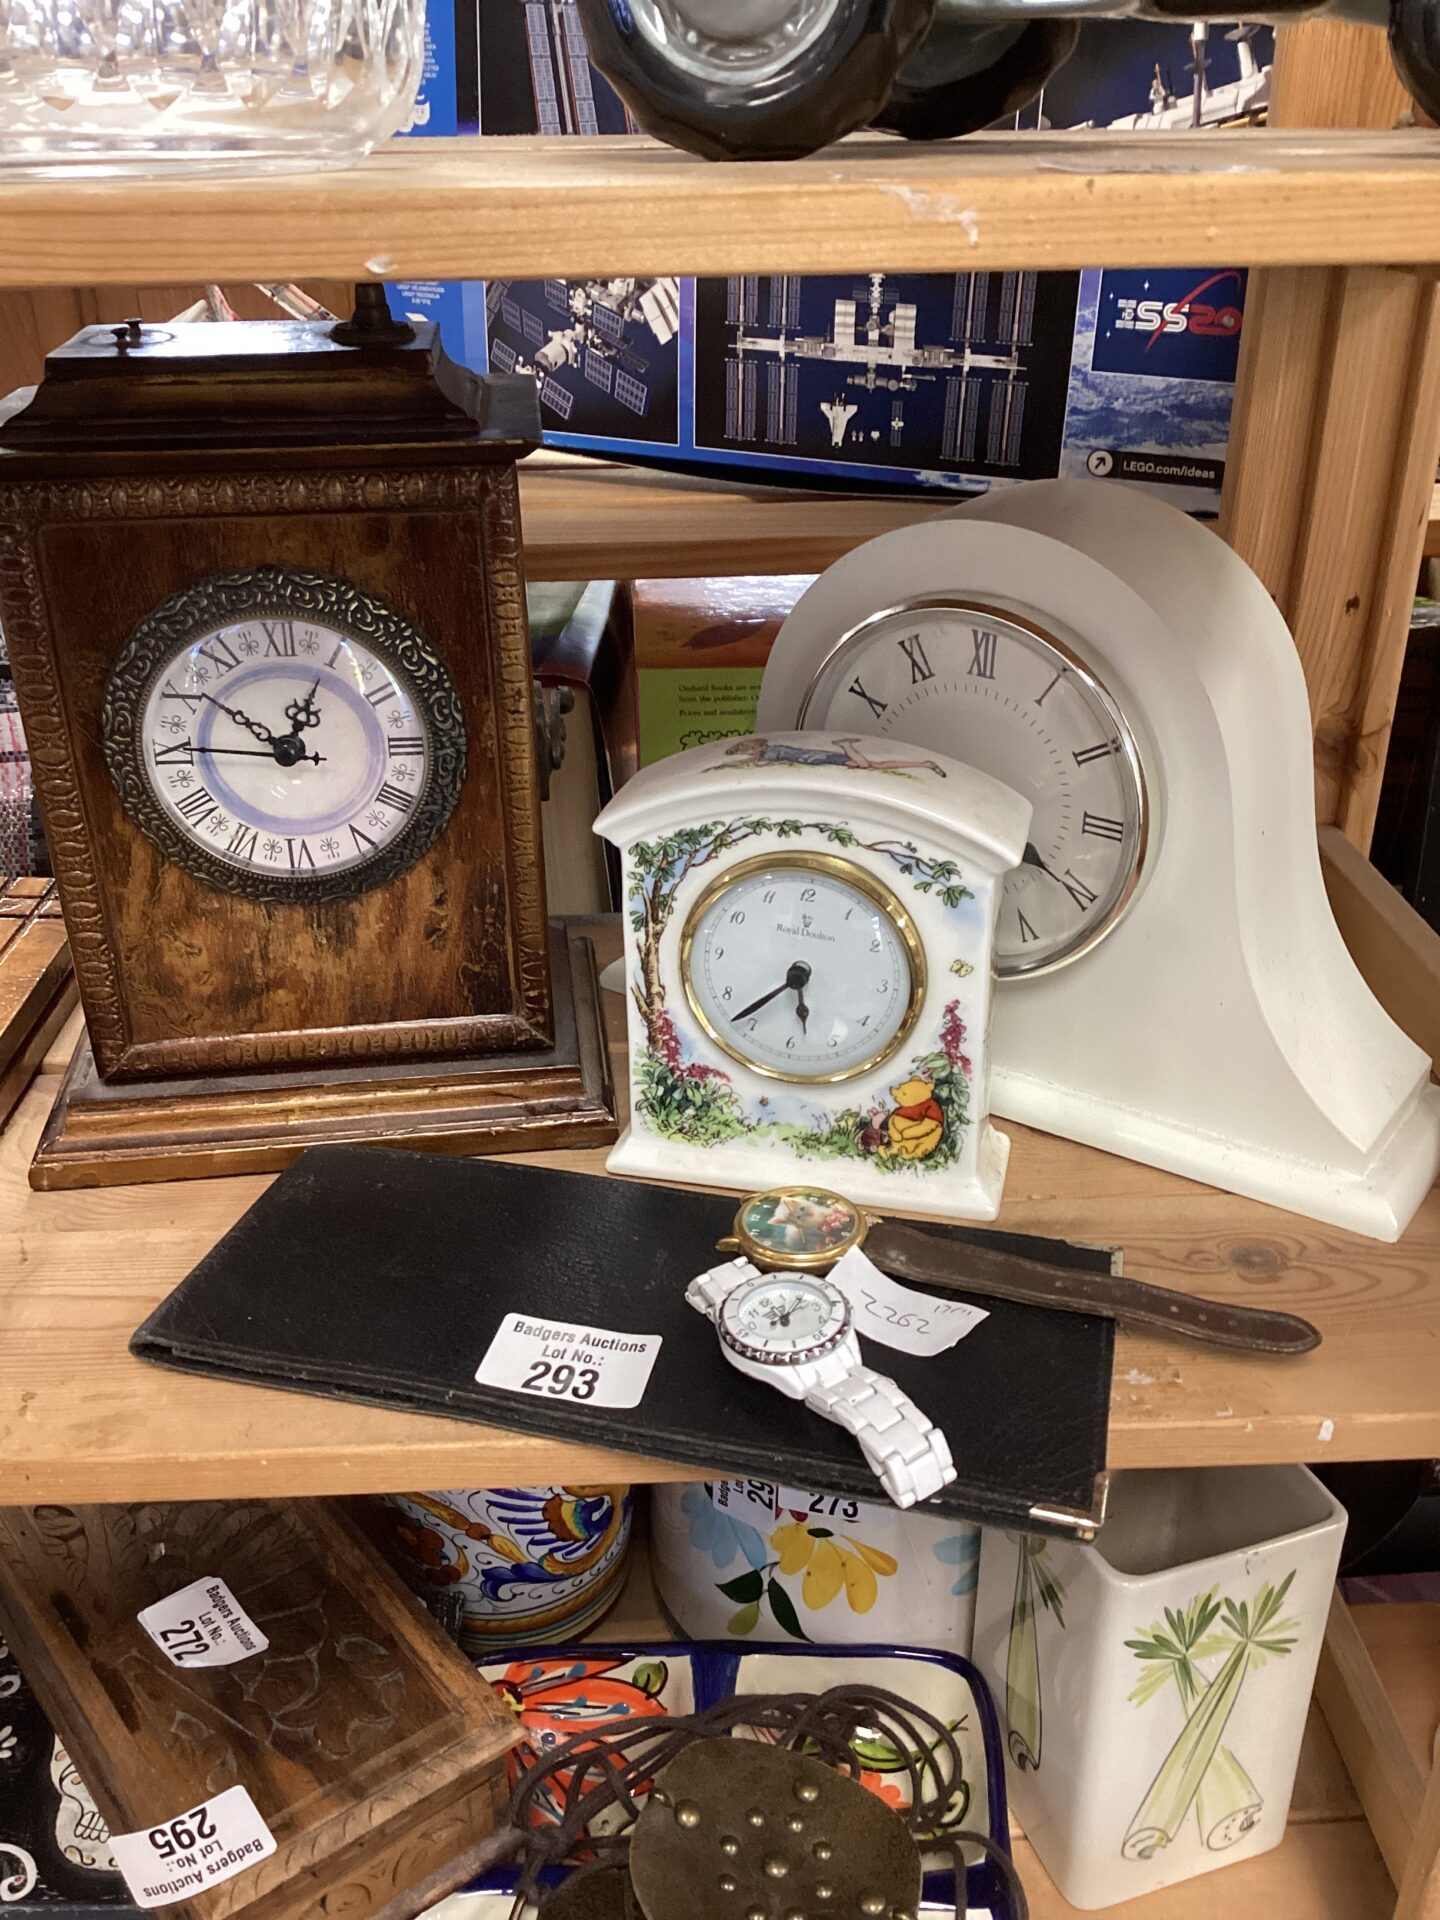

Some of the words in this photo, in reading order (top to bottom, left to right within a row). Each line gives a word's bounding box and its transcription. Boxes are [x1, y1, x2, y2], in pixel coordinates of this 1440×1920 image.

[1123, 460, 1216, 479] LEGO.com/ideas
[199, 633, 243, 671] XI
[260, 621, 298, 657] XII
[324, 638, 348, 670] I
[897, 634, 935, 684] XI
[967, 630, 998, 680] XII
[160, 679, 203, 714] X
[364, 682, 397, 708] II
[848, 677, 888, 719] X
[387, 736, 424, 758] III
[1072, 736, 1122, 767] II
[174, 787, 215, 828] VIII
[349, 824, 380, 855] V
[1082, 811, 1124, 842] III
[225, 823, 258, 862] VII
[285, 838, 318, 875] VI
[763, 890, 777, 904] 11
[800, 888, 816, 903] 12
[730, 911, 746, 925] 10
[845, 908, 853, 921] 1
[1017, 907, 1040, 943] V
[776, 923, 800, 937] Royal
[801, 927, 836, 942] Doulton
[714, 947, 724, 960] 9
[722, 986, 732, 1000] 8
[877, 979, 888, 993] 3
[747, 1017, 757, 1031] 7
[856, 1014, 871, 1028] 4
[786, 1035, 796, 1049] 6
[827, 1035, 838, 1048] 5
[513, 1320, 577, 1343] Badgers
[580, 1333, 648, 1353] Auctions
[541, 1345, 567, 1360] Lot
[571, 1351, 605, 1367] No.:
[521, 1360, 601, 1400] 293
[717, 1480, 731, 1508] Badge
[747, 1479, 775, 1511] 29
[809, 1493, 859, 1519] 273
[198, 1611, 217, 1629] Lot
[206, 1584, 234, 1620] Badgers
[226, 1617, 257, 1652] Auctions
[160, 1619, 211, 1662] 272
[148, 1806, 218, 1860] 295
[199, 1839, 224, 1858] Lot
[206, 1838, 265, 1876] Badgers
[166, 1853, 199, 1873] No.:
[143, 1870, 204, 1898] Auctions
